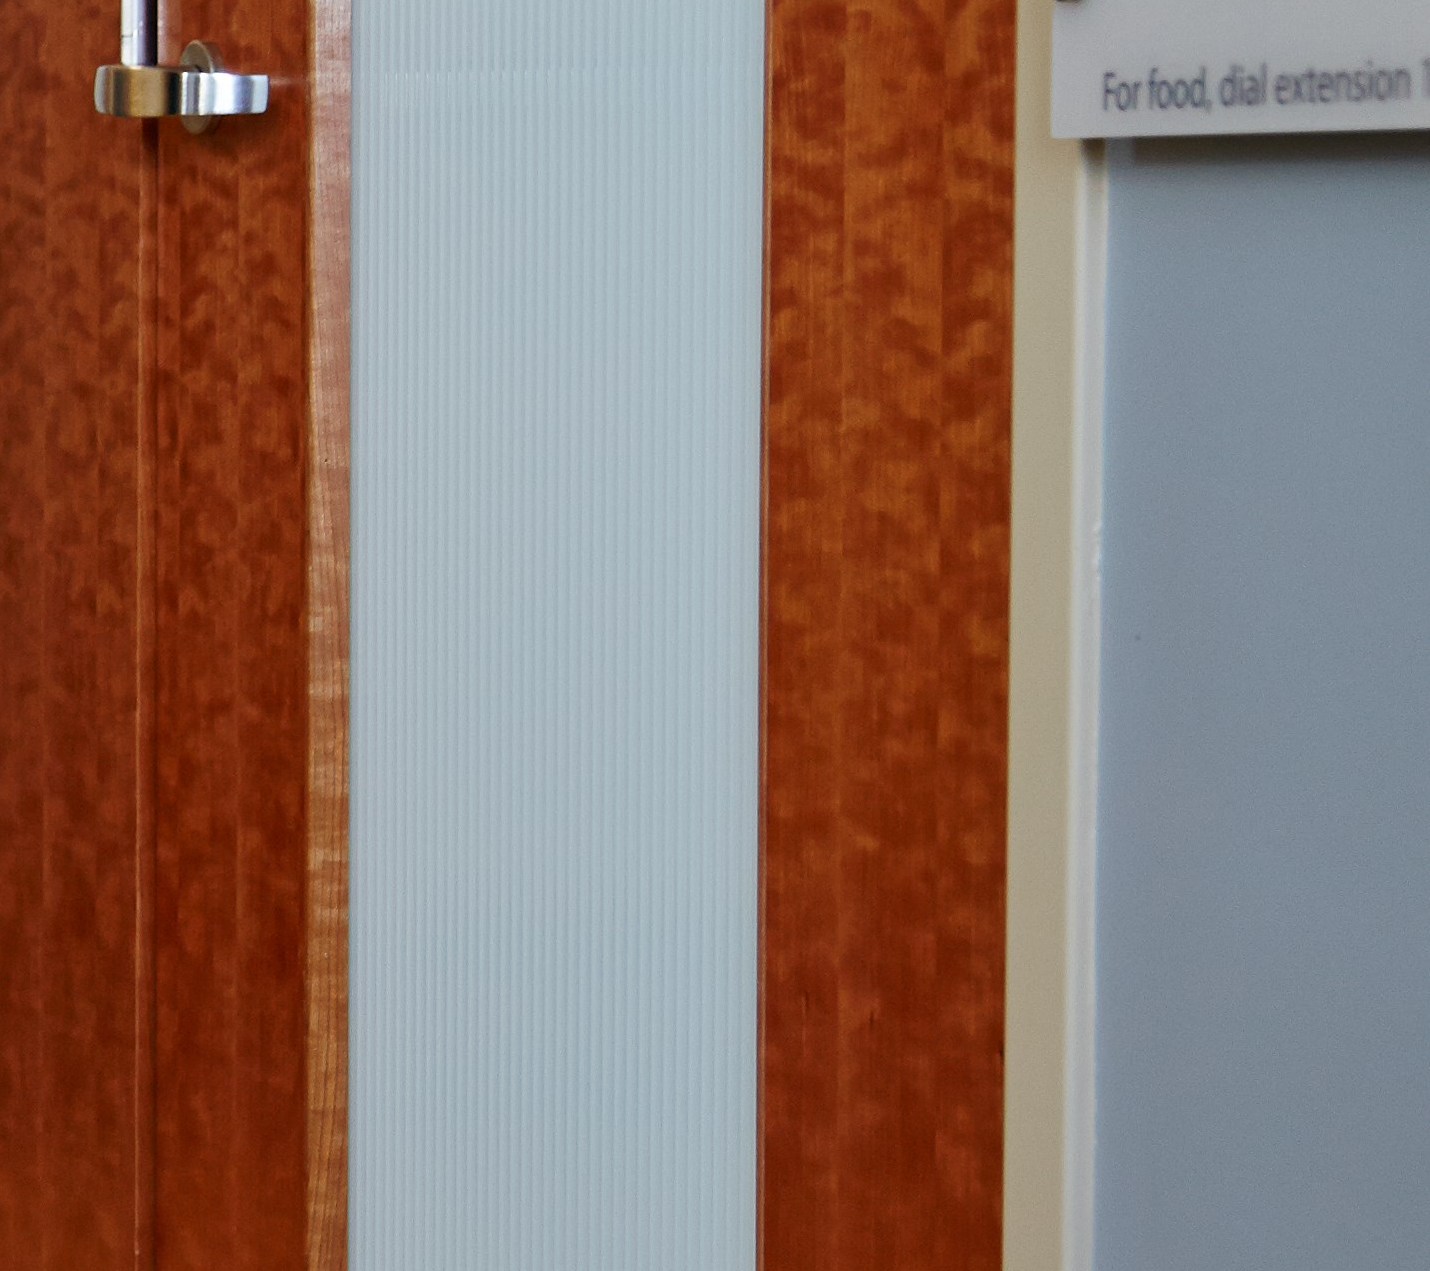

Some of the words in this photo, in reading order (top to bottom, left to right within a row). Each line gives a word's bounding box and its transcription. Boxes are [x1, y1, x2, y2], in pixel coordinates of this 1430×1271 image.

[1102, 71, 1143, 111] For
[1219, 62, 1267, 108] dial
[1274, 58, 1411, 105] extension
